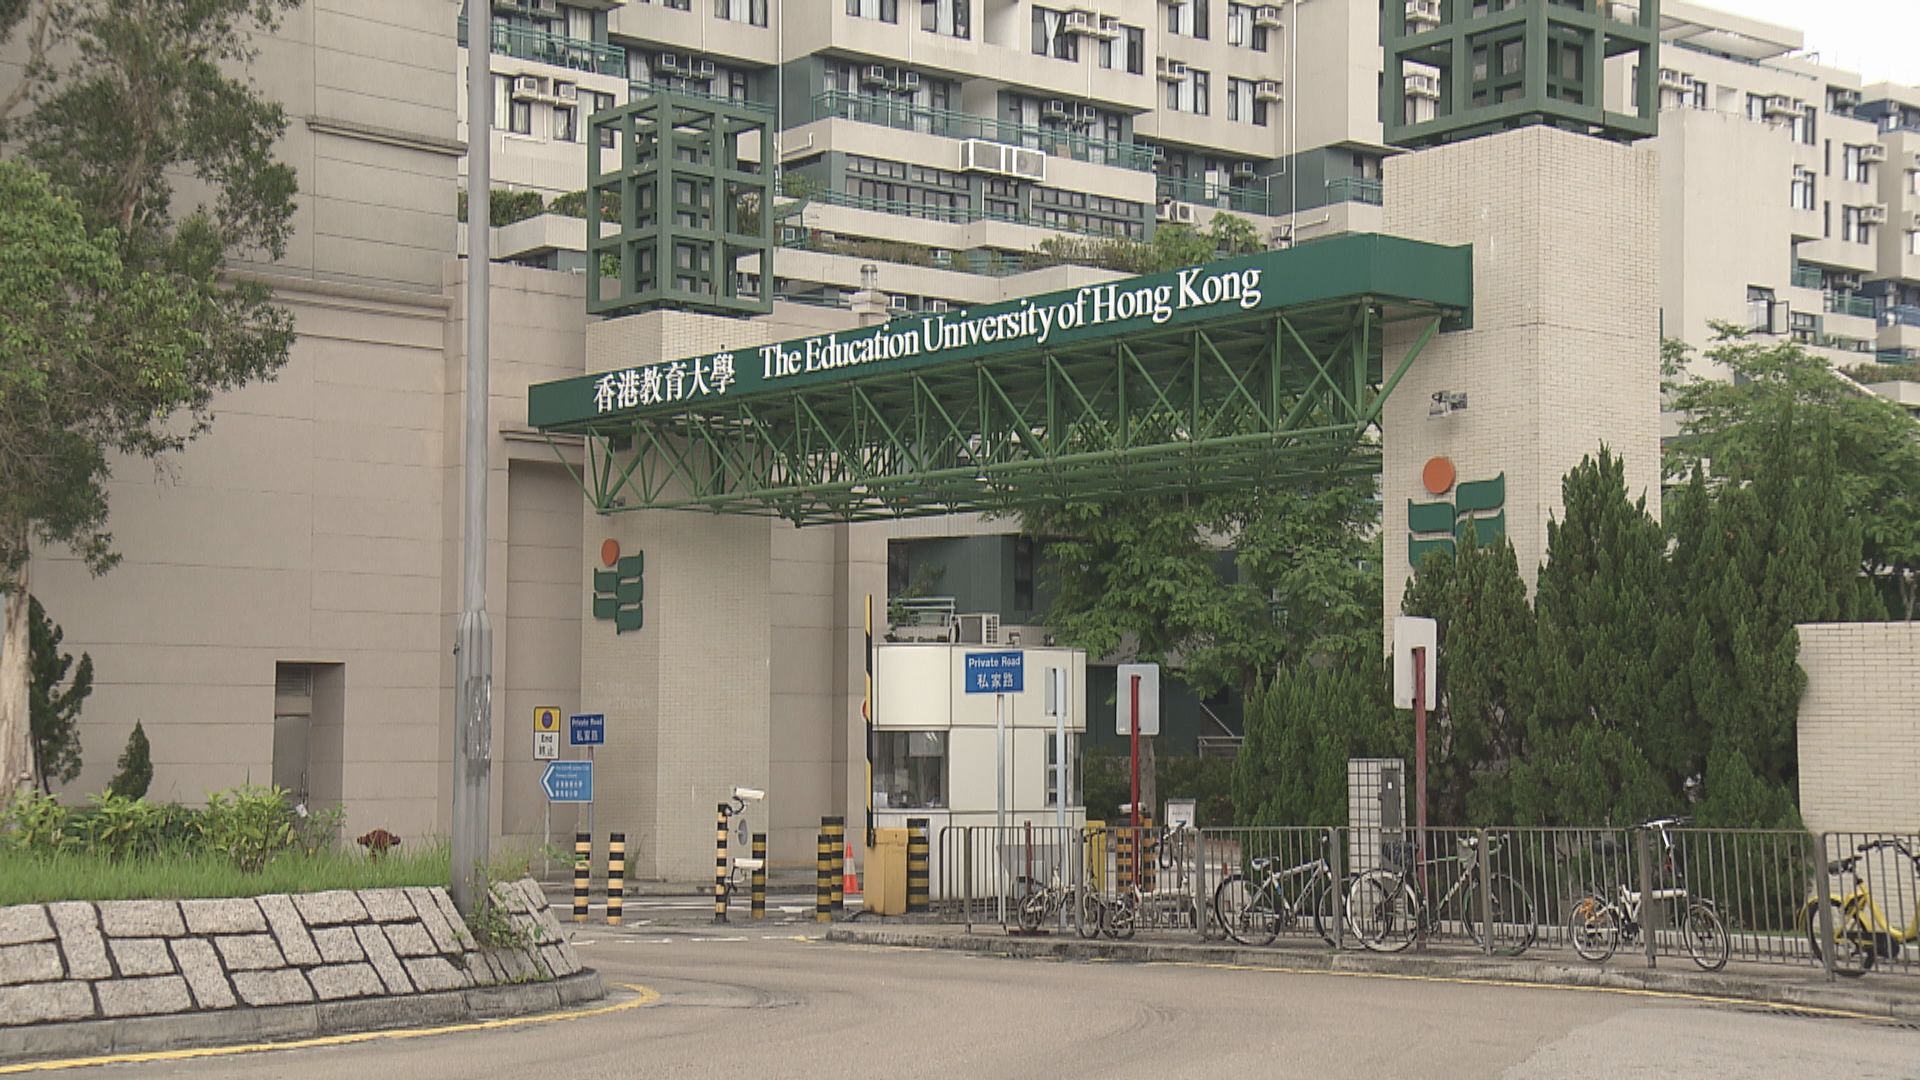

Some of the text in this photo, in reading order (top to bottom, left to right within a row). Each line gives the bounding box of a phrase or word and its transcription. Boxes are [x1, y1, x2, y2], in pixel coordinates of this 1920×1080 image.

[758, 267, 1263, 379] The Education University of Hong Kong
[593, 353, 736, 414] 香港教育大學
[968, 655, 1021, 668] Private Road
[976, 671, 1014, 689] 私家路
[541, 734, 552, 743] End
